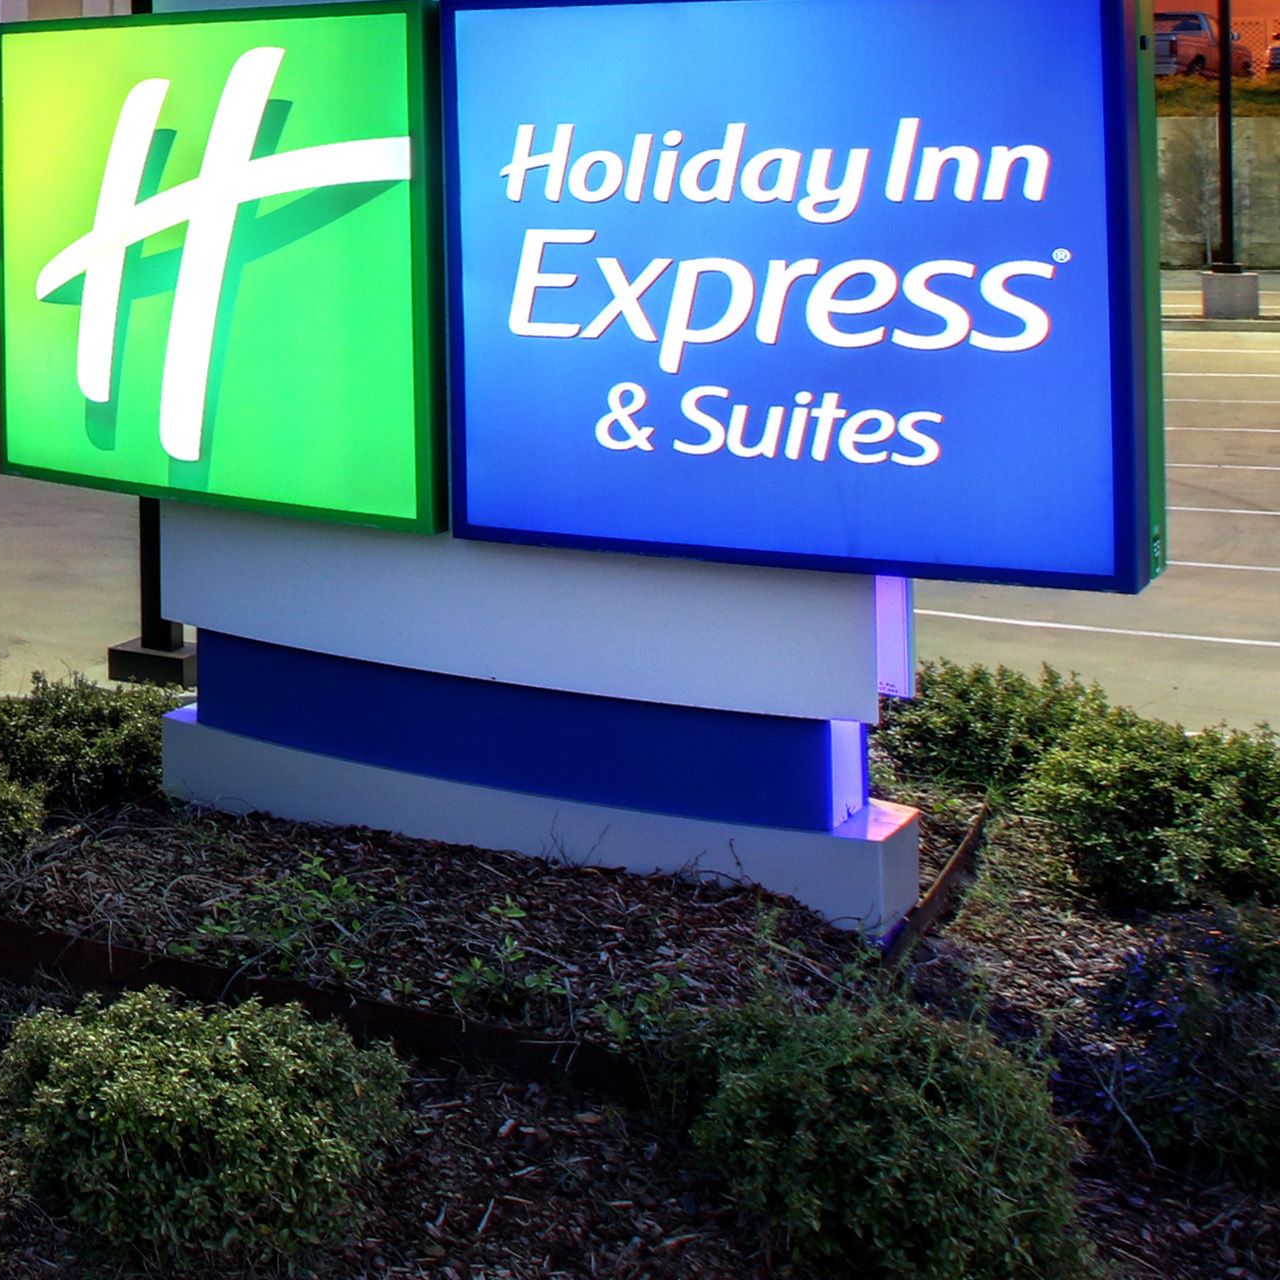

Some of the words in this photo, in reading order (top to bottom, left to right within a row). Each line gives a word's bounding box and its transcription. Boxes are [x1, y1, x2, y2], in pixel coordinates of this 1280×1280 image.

[500, 122, 870, 224] Holiday
[886, 117, 1049, 202] Inn
[595, 382, 654, 451] &
[673, 385, 943, 466] Suites
